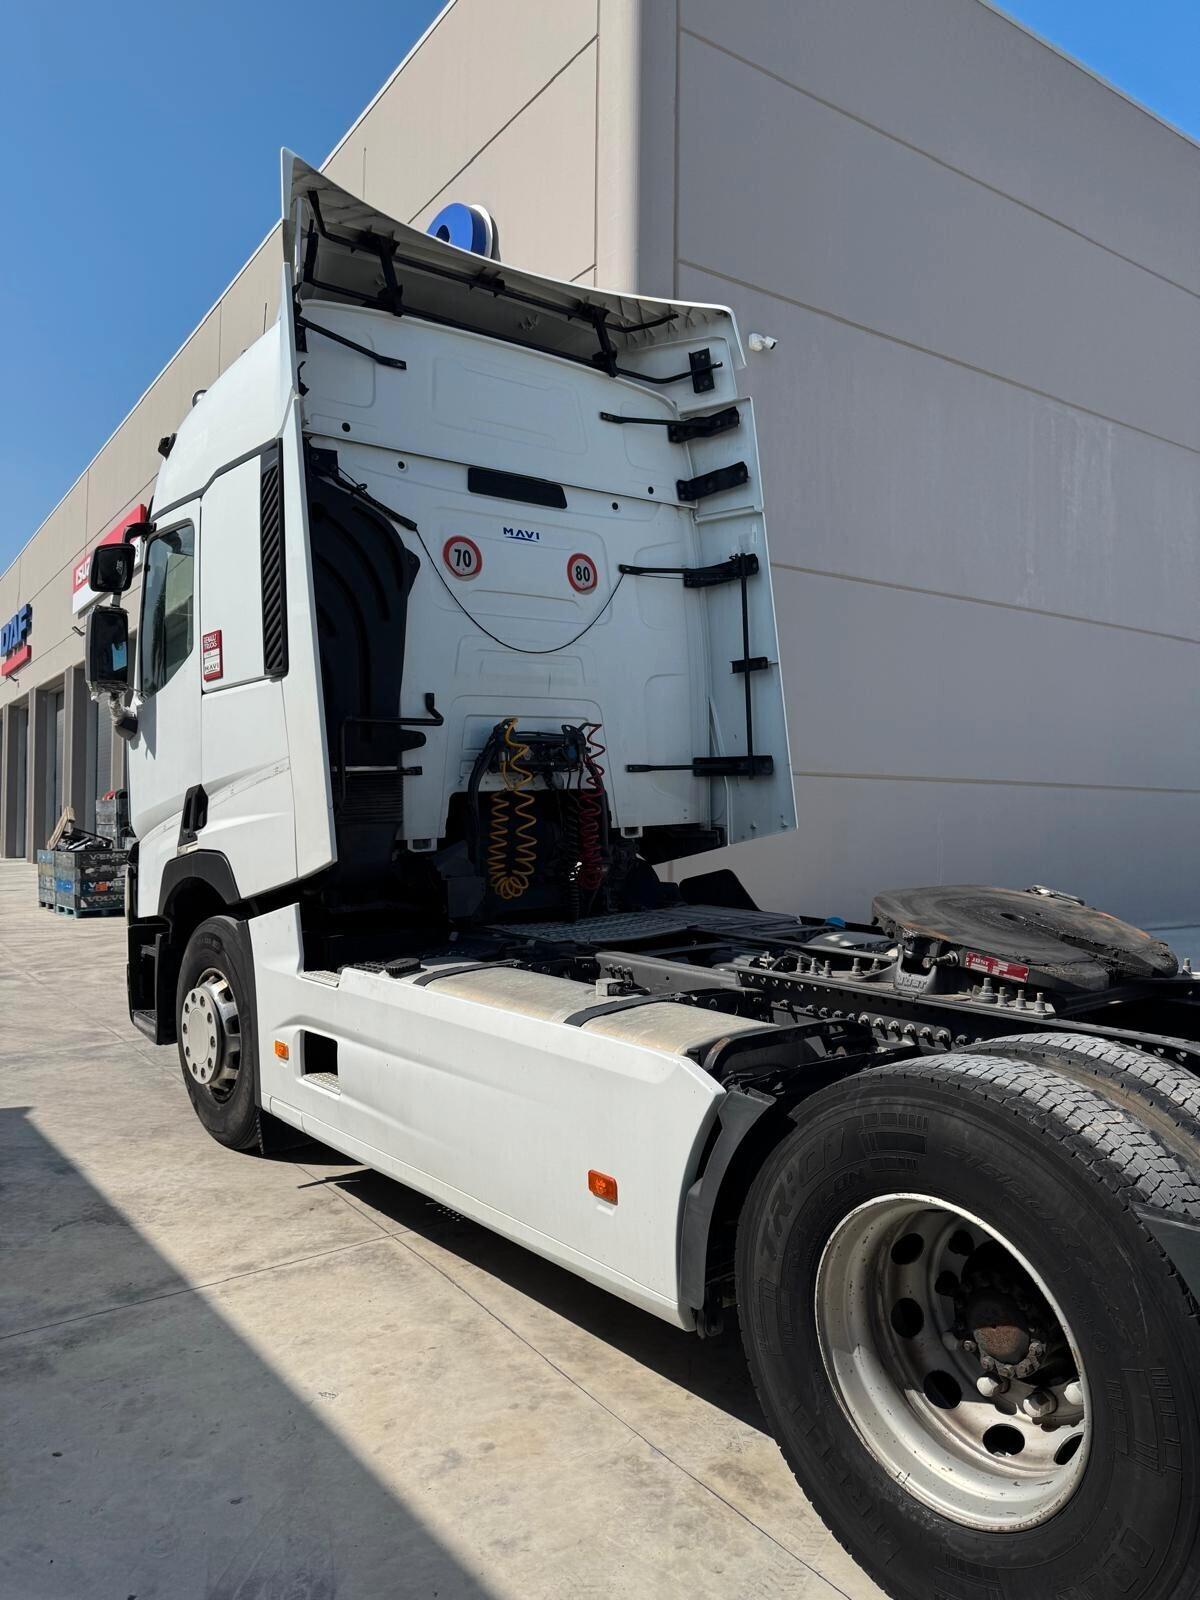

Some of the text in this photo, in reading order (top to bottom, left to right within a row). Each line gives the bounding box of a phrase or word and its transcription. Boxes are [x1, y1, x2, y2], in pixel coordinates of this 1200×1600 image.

[503, 527, 540, 541] MAVI
[454, 549, 472, 568] 70
[575, 565, 591, 582] 80
[0, 604, 29, 657] DAF
[972, 957, 990, 966] JOST
